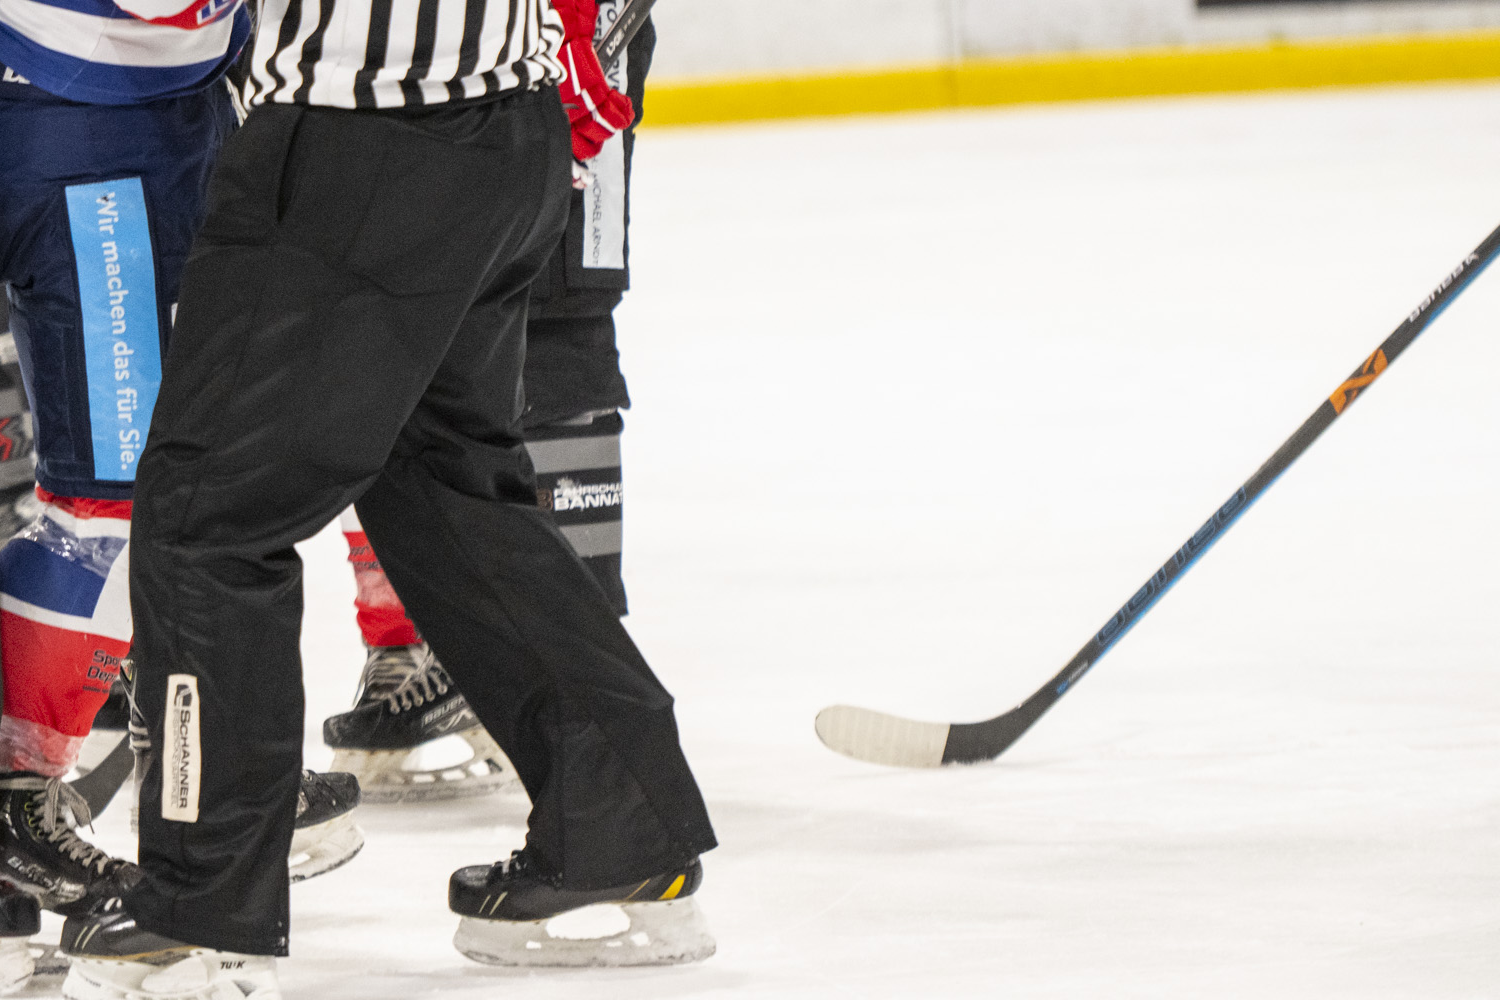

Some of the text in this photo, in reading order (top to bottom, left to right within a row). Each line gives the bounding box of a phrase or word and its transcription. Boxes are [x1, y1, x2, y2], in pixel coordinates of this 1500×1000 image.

[96, 191, 141, 471] Wir machen das für Sie.
[178, 709, 192, 810] SCHANNER
